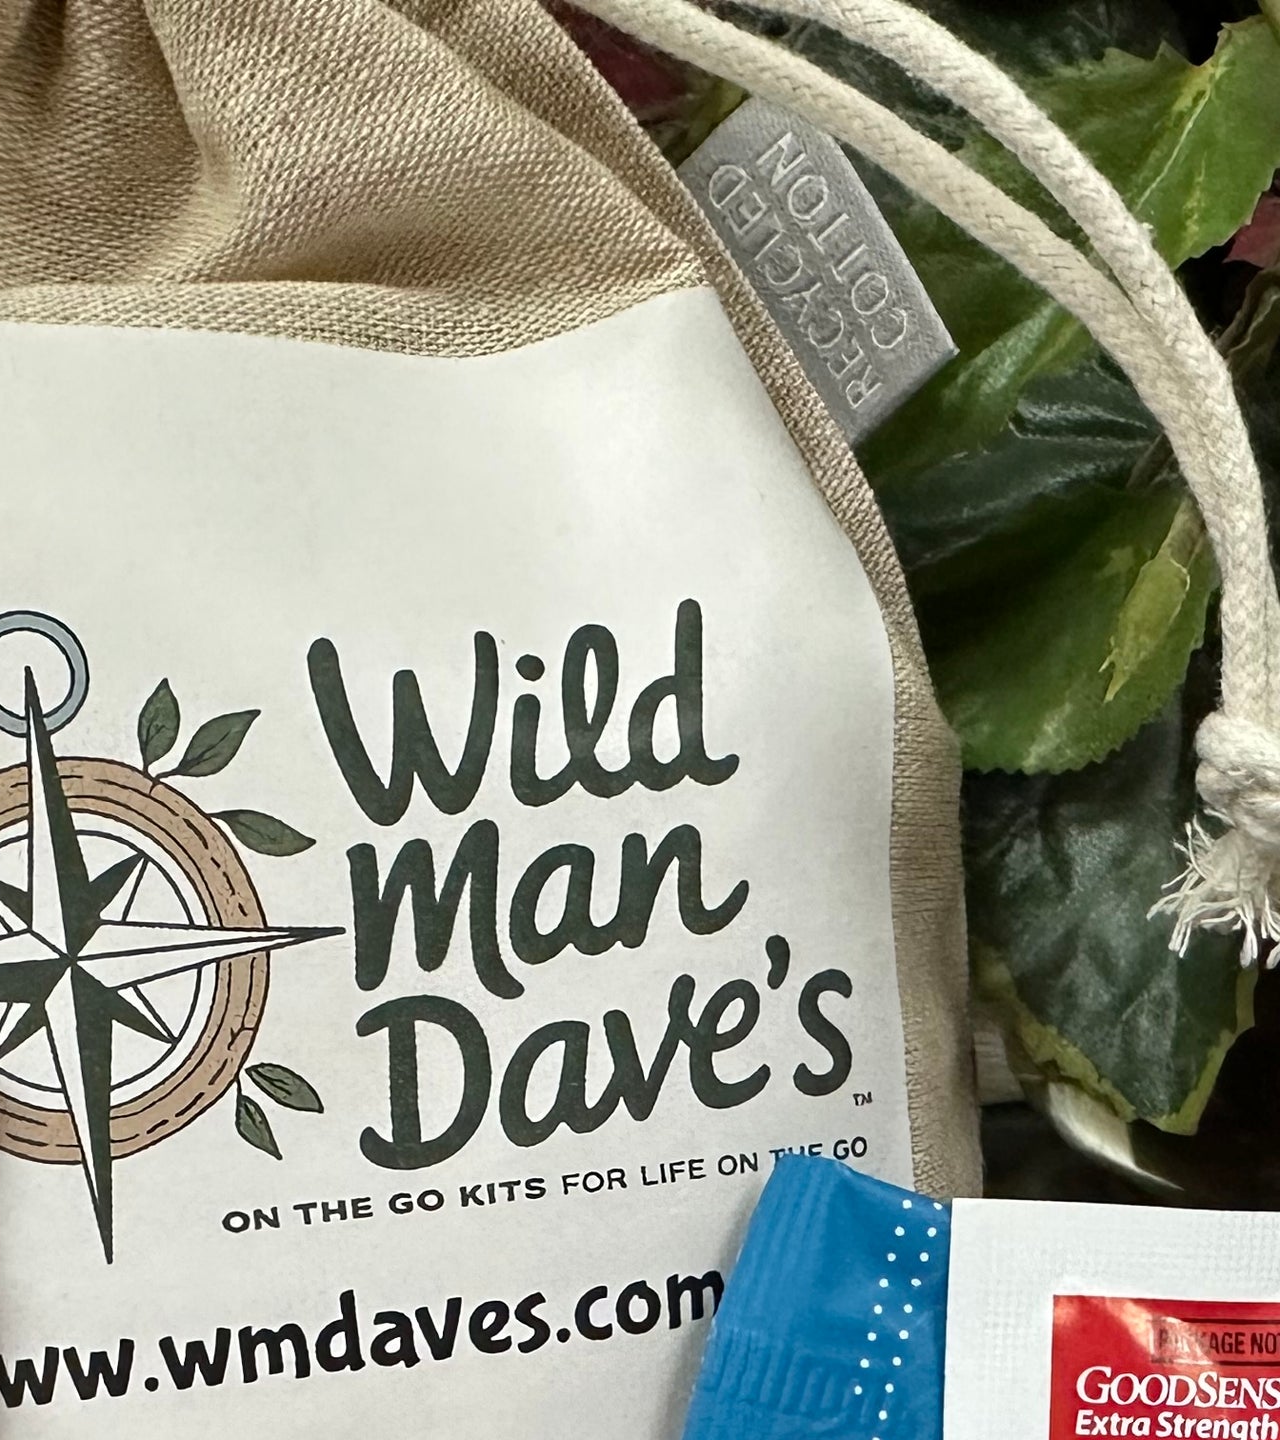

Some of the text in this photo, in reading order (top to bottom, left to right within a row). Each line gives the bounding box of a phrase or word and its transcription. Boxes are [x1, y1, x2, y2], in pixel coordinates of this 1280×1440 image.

[709, 164, 882, 409] RECYCLED
[756, 132, 906, 349] COTTON
[307, 598, 739, 826] Wild
[347, 820, 749, 999] Man
[356, 935, 853, 1170] Dave's
[222, 1207, 280, 1234] ON
[294, 1197, 373, 1224] THE
[388, 1189, 444, 1215] GO
[460, 1177, 546, 1206] KITS
[562, 1168, 627, 1195] FOR
[641, 1157, 707, 1185] LIFE
[717, 1150, 760, 1176] ON
[833, 1136, 869, 1161] GO
[1075, 1409, 1151, 1436] Extra
